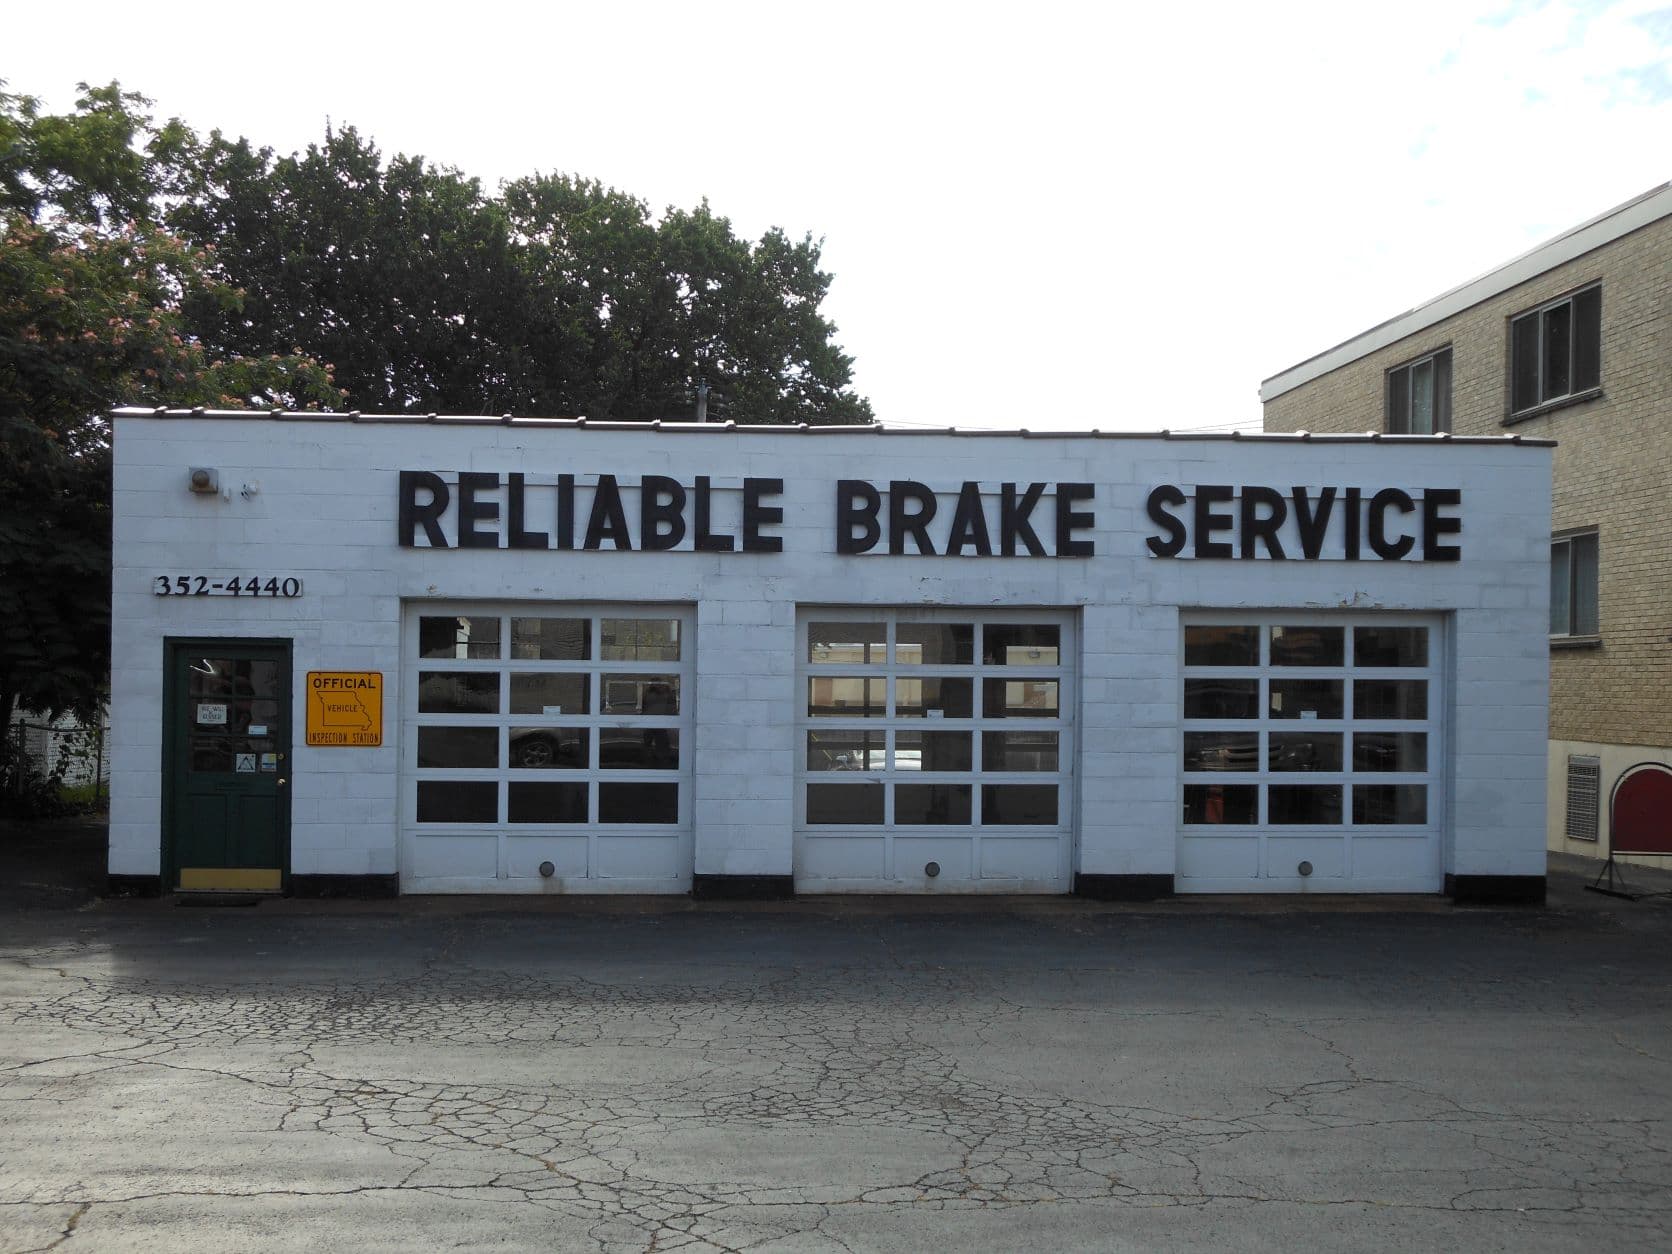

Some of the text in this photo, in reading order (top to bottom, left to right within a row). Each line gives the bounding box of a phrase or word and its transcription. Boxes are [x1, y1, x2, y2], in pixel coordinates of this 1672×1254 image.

[399, 471, 1461, 561] RELIABLE BRAKE SERVICE
[156, 576, 299, 597] 352-4440
[313, 678, 376, 689] OFFICIAL
[327, 704, 358, 713] VEHICLE
[309, 732, 378, 744] INSPECTION STATION
